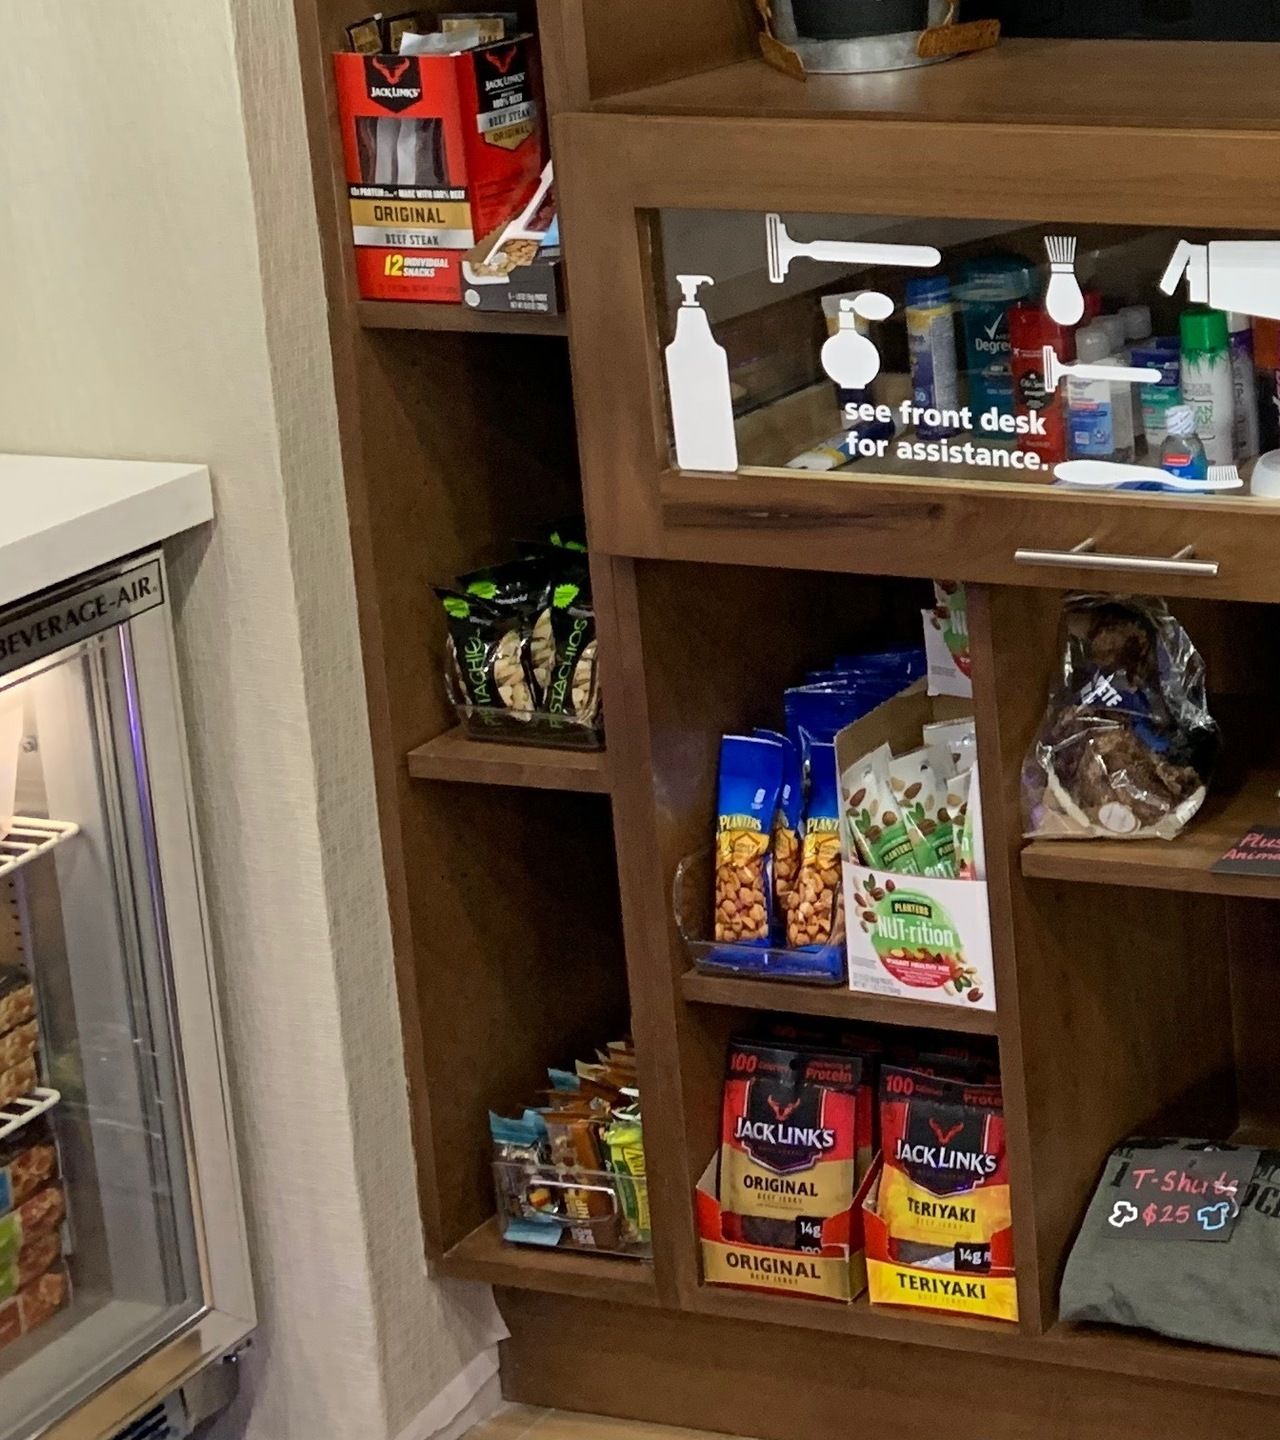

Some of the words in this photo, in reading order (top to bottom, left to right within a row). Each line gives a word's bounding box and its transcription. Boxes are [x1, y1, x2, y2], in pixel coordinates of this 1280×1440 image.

[374, 205, 446, 223] ORIGINAL
[386, 233, 406, 244] BEEF
[410, 234, 439, 246] STEAK
[384, 255, 403, 276] 12
[845, 401, 891, 422] see
[900, 400, 973, 430] front
[981, 407, 1047, 435] desk
[846, 432, 888, 457] for
[897, 438, 1048, 471] assistance.
[550, 619, 588, 728] PSTACHIOS
[719, 814, 763, 832] PLANTERS
[894, 902, 930, 917] PLANTERS
[806, 1065, 852, 1082] Protein
[885, 1075, 914, 1096] 100
[735, 1117, 776, 1143] JACK
[777, 1122, 835, 1149] LINK'S
[895, 1140, 937, 1167] JACK
[937, 1147, 998, 1175] LINK'S
[743, 1174, 818, 1197] ORIGINAL
[907, 1197, 977, 1223] TERIYAKI
[1141, 1203, 1190, 1227] $25
[800, 1221, 821, 1240] 14g
[725, 1251, 822, 1280] ORIGINAL
[958, 1248, 982, 1265] 14g
[896, 1272, 987, 1300] TERIYAKI
